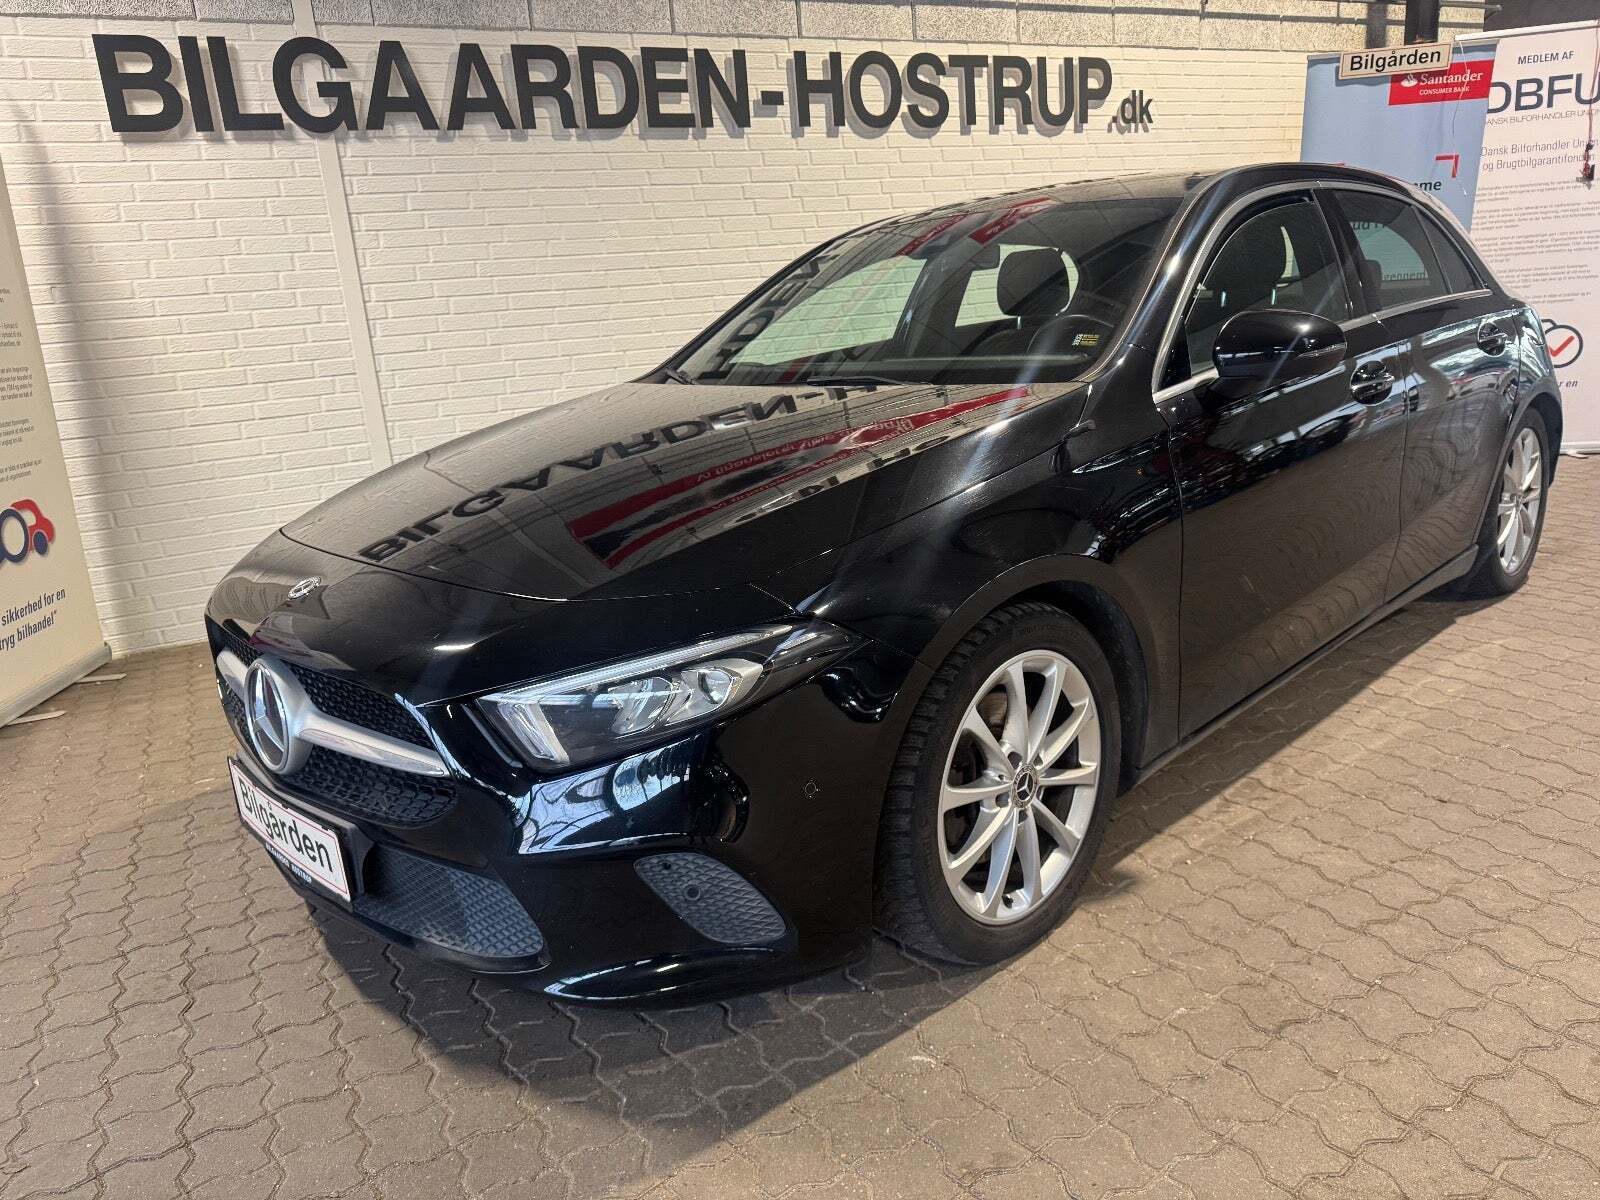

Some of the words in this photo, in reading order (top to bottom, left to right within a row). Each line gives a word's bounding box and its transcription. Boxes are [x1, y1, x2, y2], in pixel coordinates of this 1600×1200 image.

[1350, 49, 1441, 72] Bilgården
[1518, 52, 1559, 64] MEDLEM
[1562, 51, 1575, 60] AF
[1419, 69, 1483, 85] Santander
[1419, 88, 1452, 96] CONSUMER
[1487, 72, 1600, 114] DBFU
[1487, 117, 1509, 125] ANSK
[1509, 111, 1576, 124] BILFORHANDLER
[1481, 145, 1508, 156] Dansk
[1511, 140, 1569, 154] Bilforhandler
[1483, 163, 1494, 172] og
[1, 595, 42, 626] sikkerhed
[44, 592, 54, 607] for
[56, 588, 66, 600] en
[238, 776, 334, 873] Bilgården
